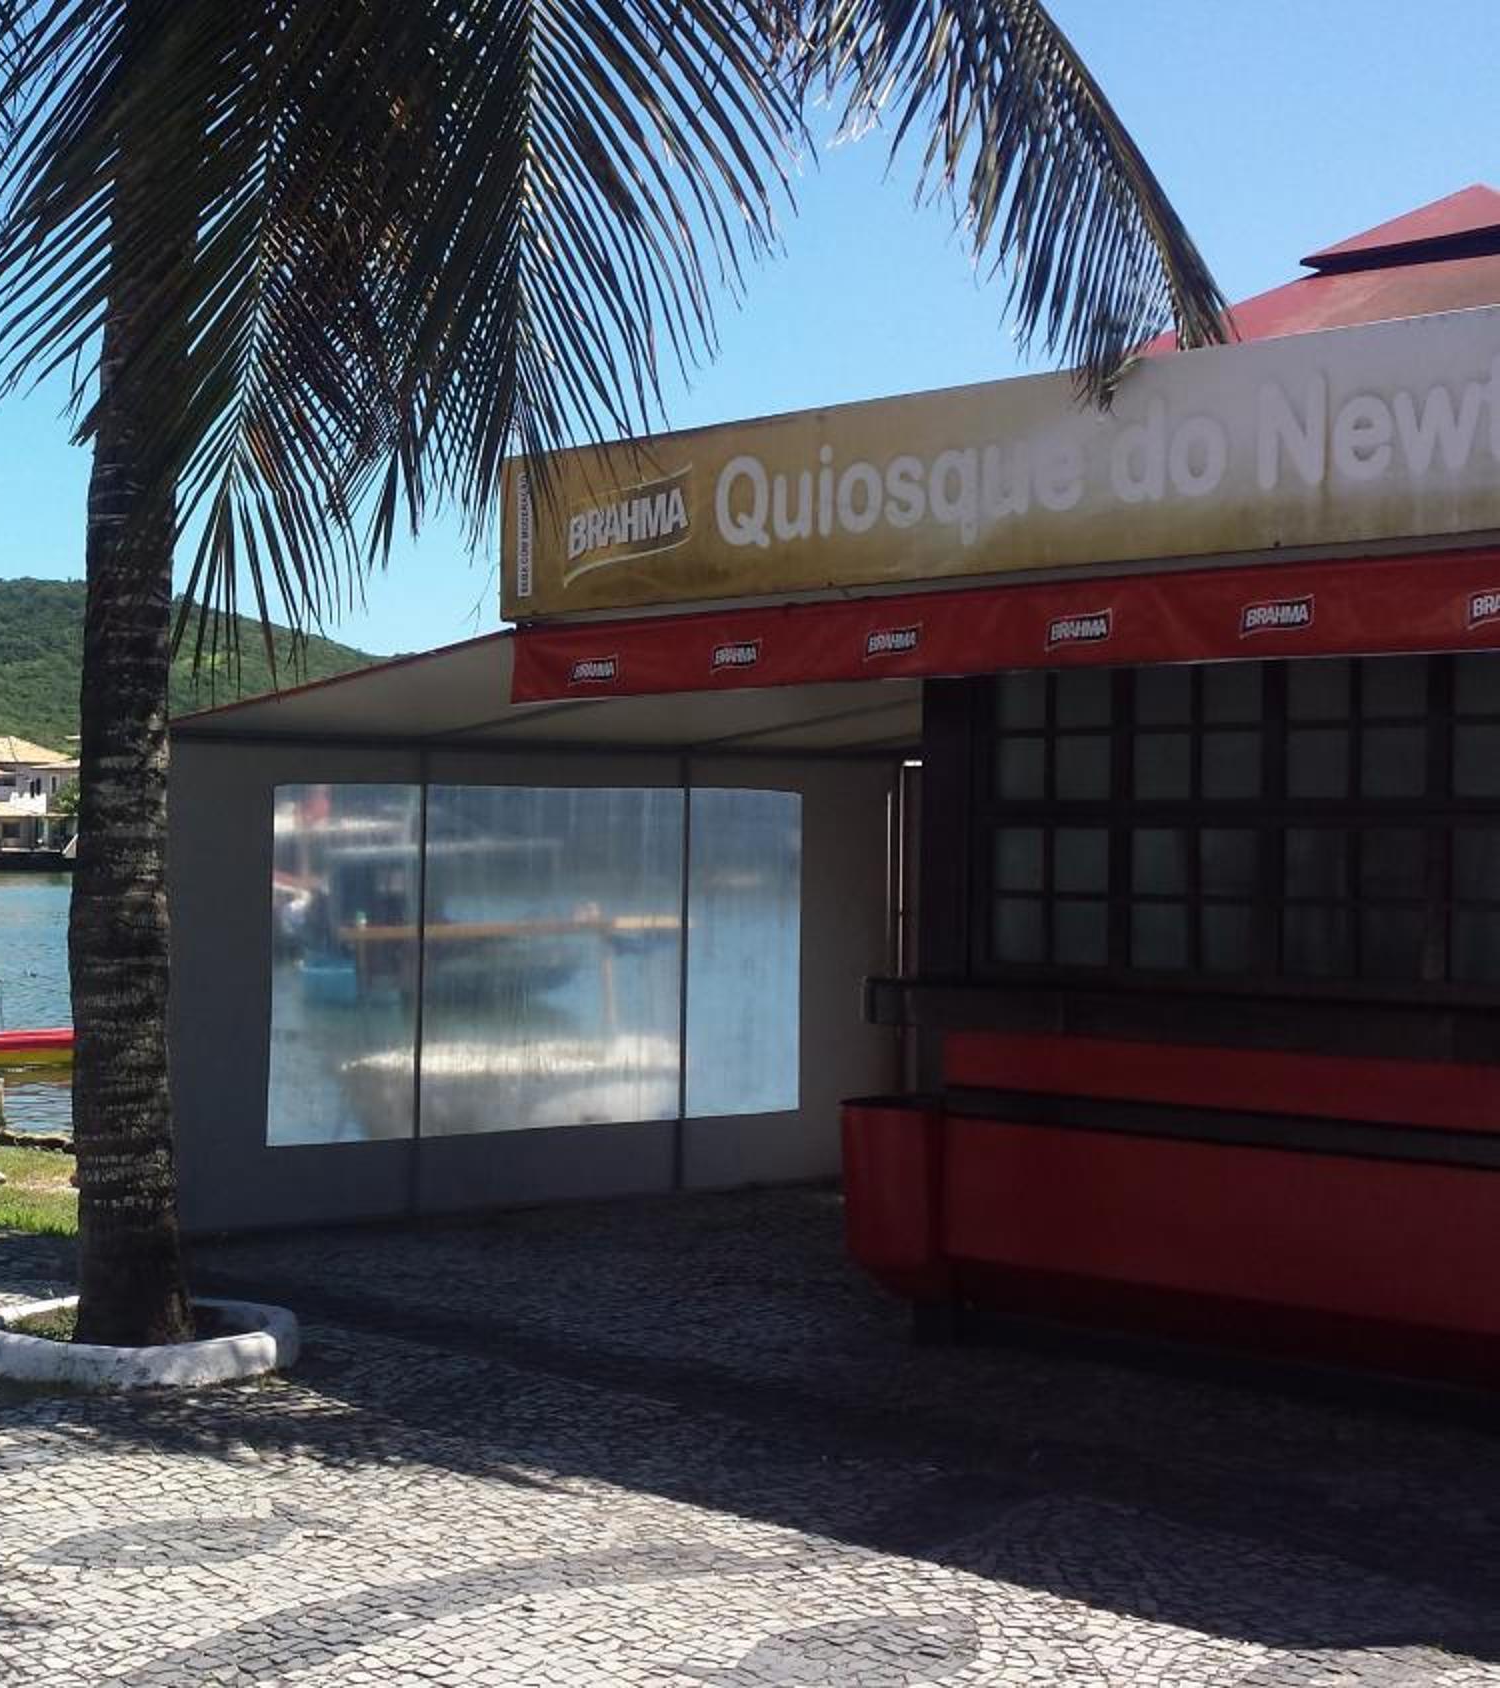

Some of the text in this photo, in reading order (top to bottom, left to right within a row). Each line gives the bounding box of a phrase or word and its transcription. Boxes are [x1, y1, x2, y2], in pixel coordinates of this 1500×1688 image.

[715, 429, 1086, 548] Quiosque
[1111, 396, 1227, 503] do
[566, 487, 690, 560] BRAHMA
[1246, 601, 1310, 628] BRAHMA
[867, 630, 918, 653] BRAHMA
[1050, 618, 1108, 643] BRAHMA
